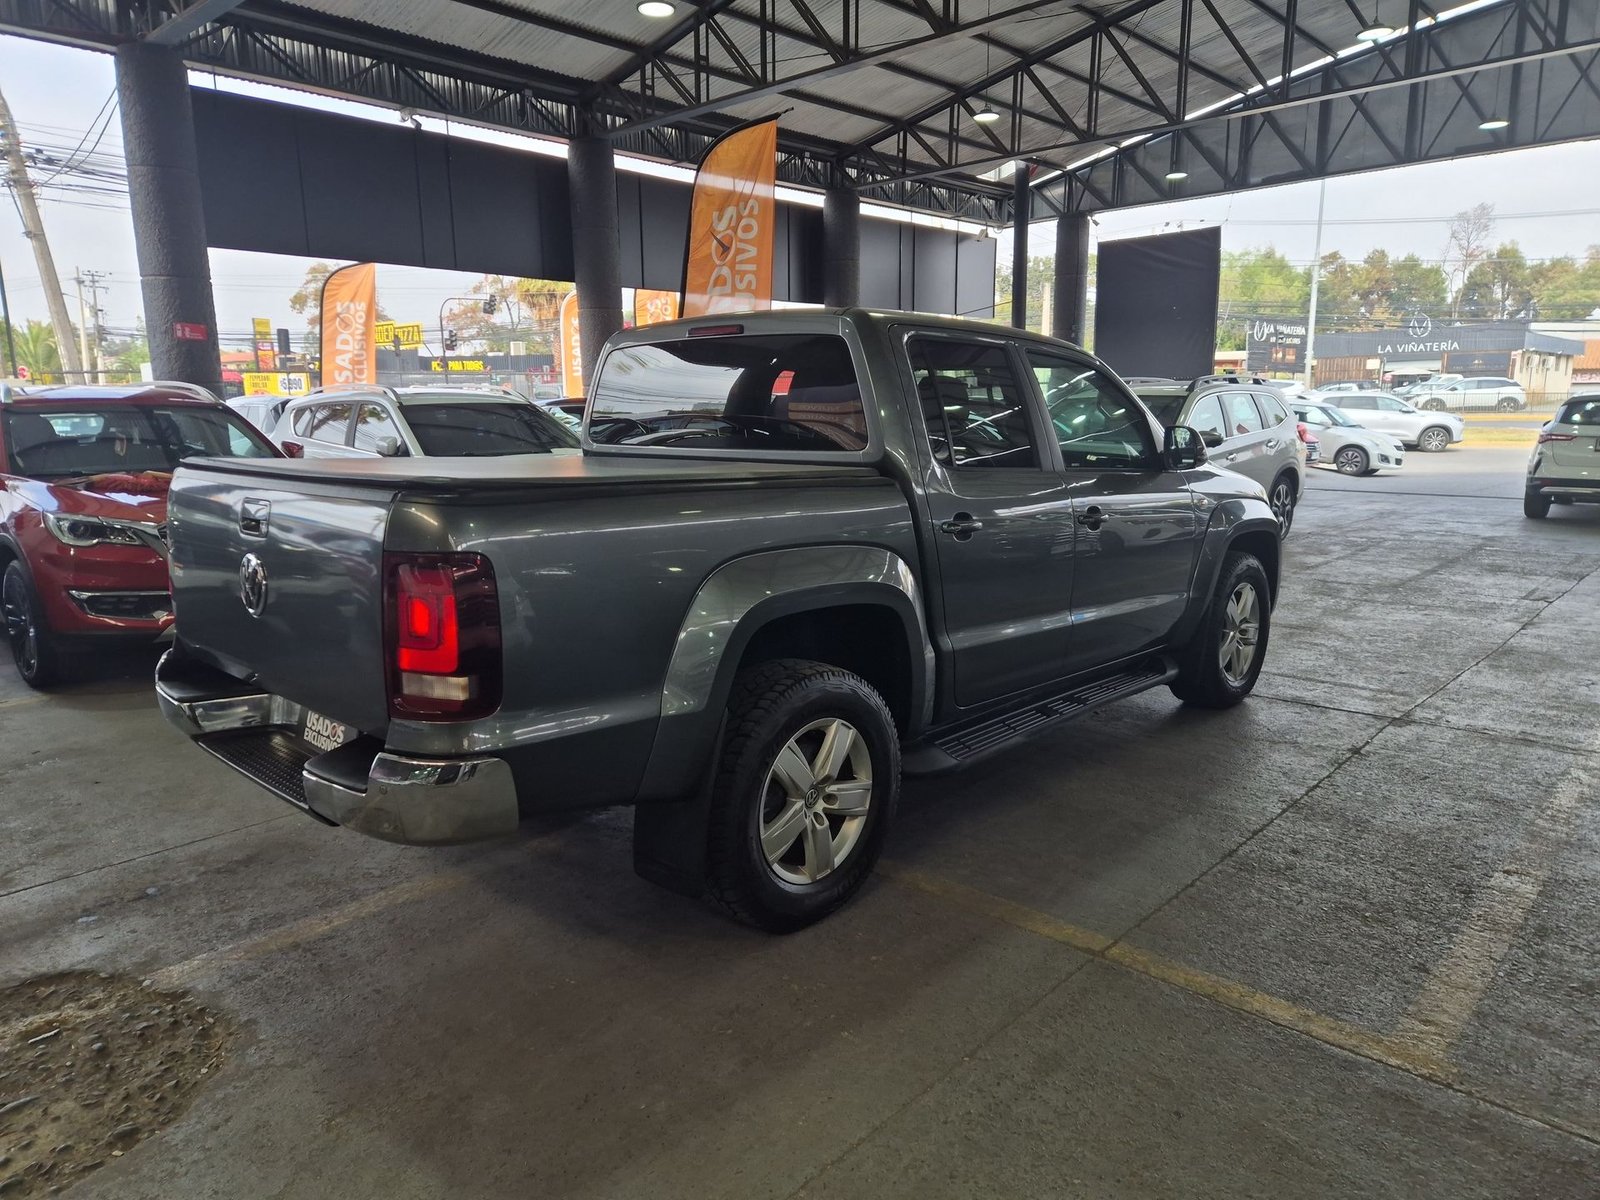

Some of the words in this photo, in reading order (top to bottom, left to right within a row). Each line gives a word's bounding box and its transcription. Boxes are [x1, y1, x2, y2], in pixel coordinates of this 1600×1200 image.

[1378, 345, 1393, 354] LA
[1397, 340, 1460, 353] VIÑATERÍA
[306, 710, 346, 743] USADOS
